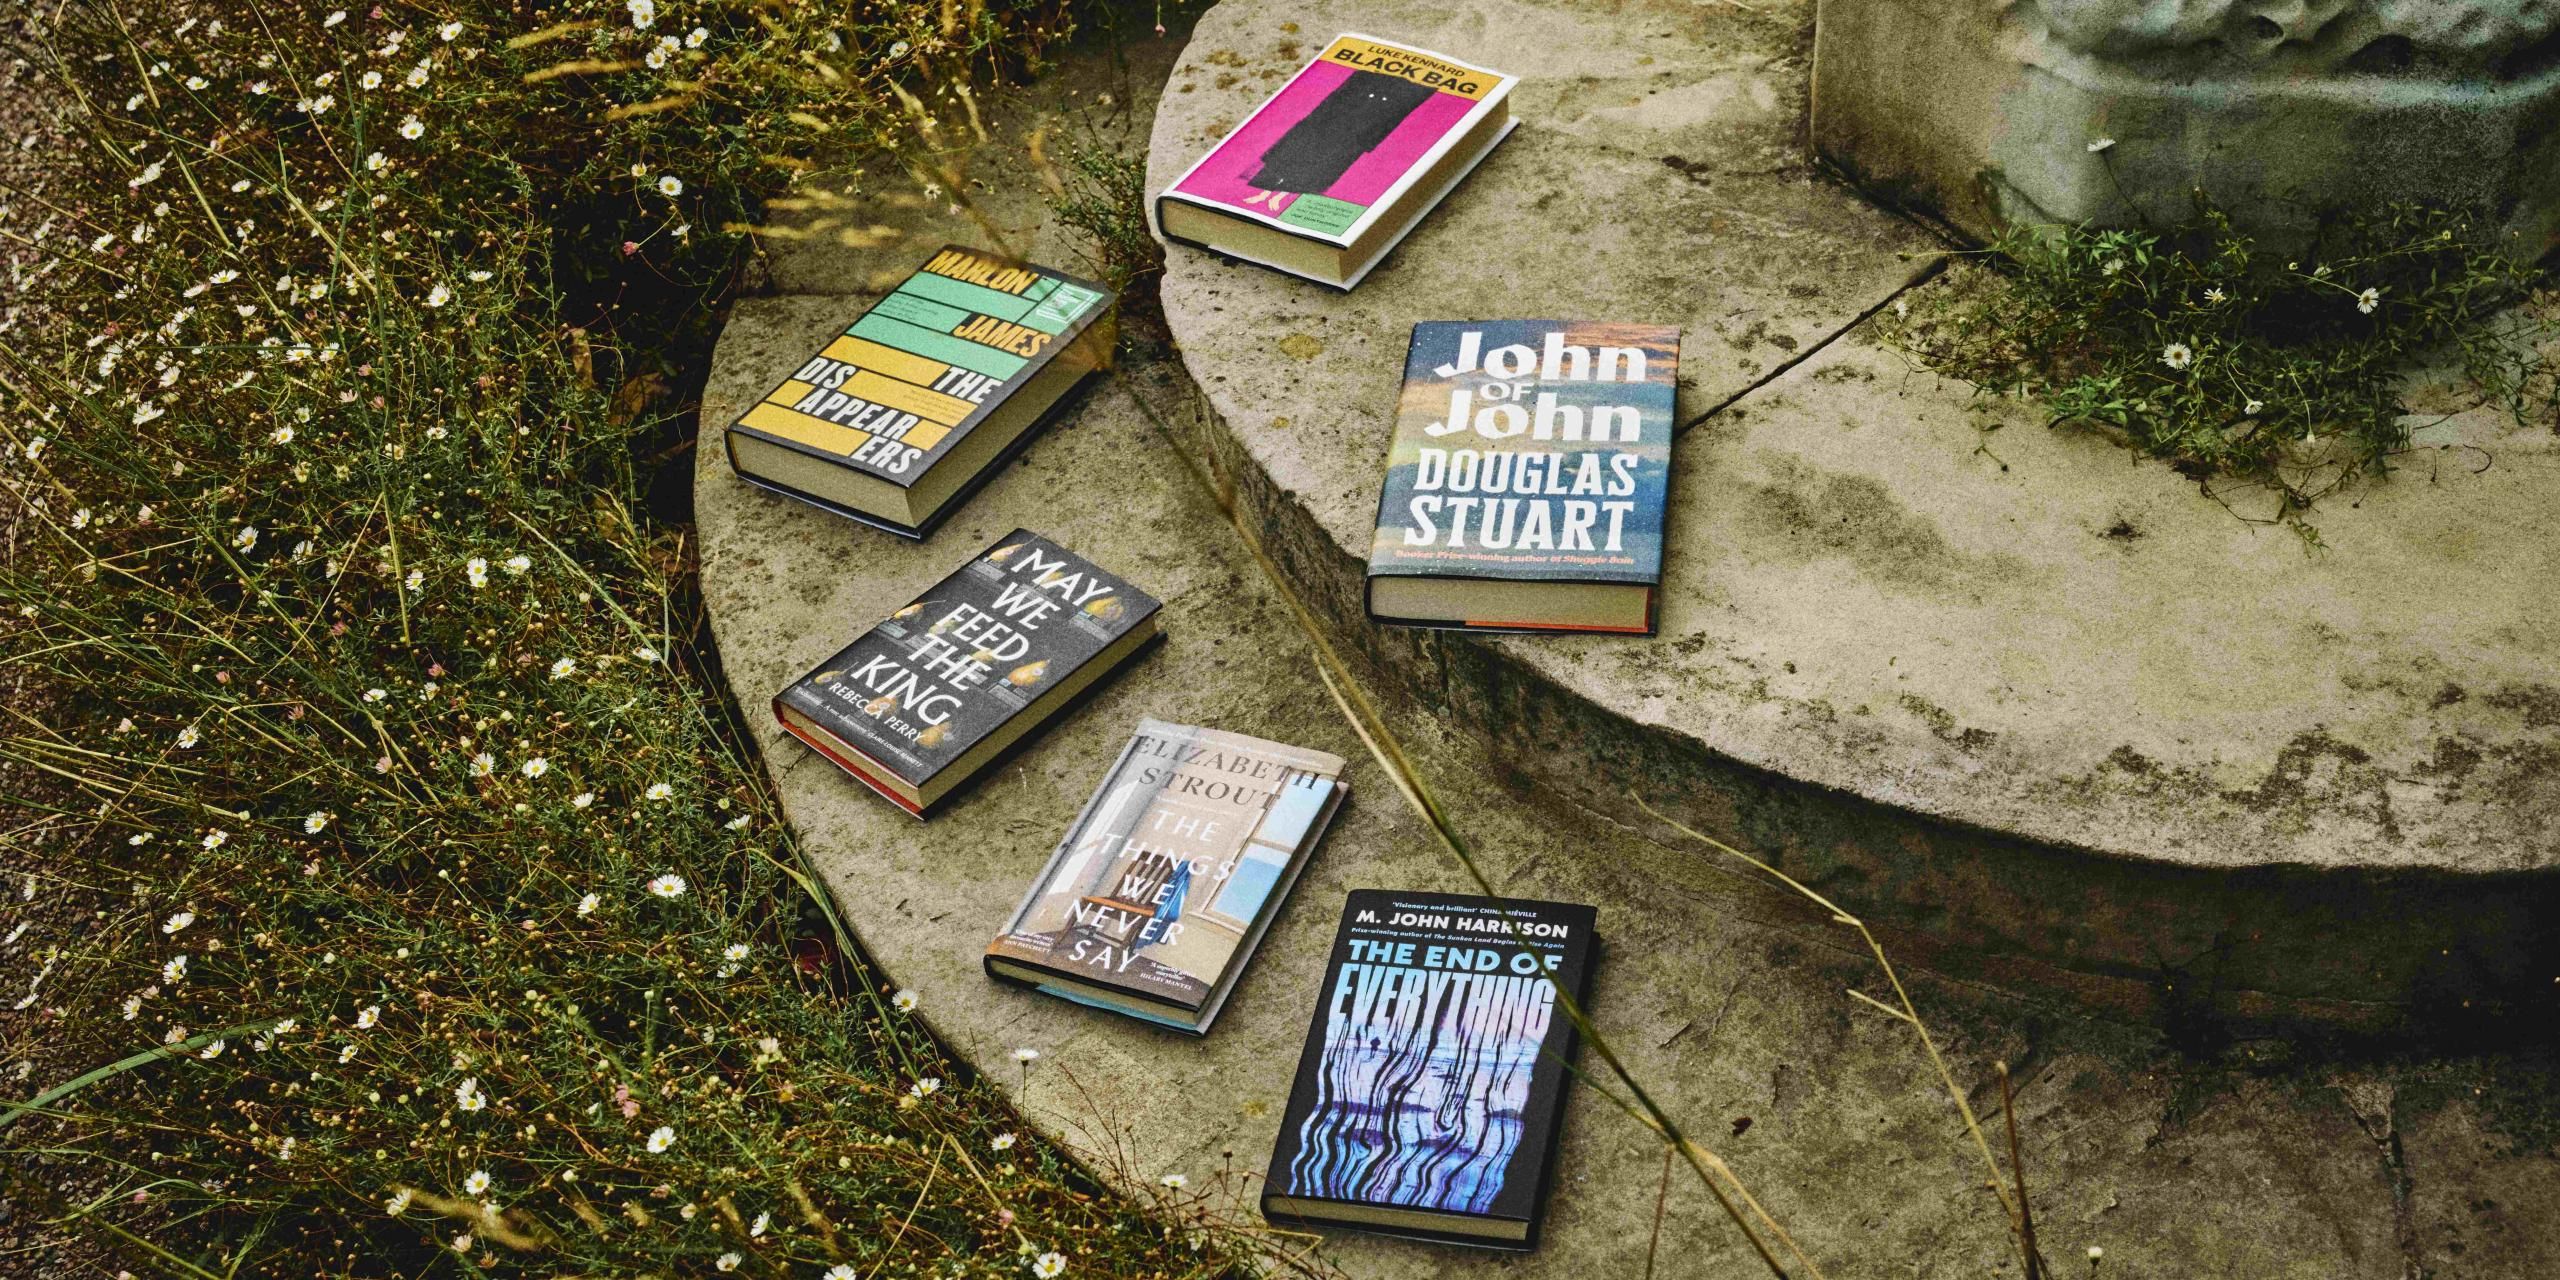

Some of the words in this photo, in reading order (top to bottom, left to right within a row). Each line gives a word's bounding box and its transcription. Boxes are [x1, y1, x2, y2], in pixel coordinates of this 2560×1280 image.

[1334, 48, 1422, 79] BLACK
[1422, 71, 1479, 95] BAG
[1367, 46, 1403, 59] LUKE
[1402, 53, 1465, 77] KENNARD
[923, 249, 1040, 295] MARLON
[952, 315, 1052, 358] JAMES
[1433, 331, 1648, 382] John
[793, 357, 857, 390] DIS
[933, 366, 1004, 404] THE
[1479, 382, 1535, 401] OF
[793, 387, 920, 439] APPEAR
[1423, 390, 1641, 442] John
[851, 435, 922, 475] ERS
[1412, 447, 1638, 497] DOUGLAS
[1403, 495, 1635, 551] STUART
[1011, 547, 1113, 607] MAY
[1510, 555, 1547, 563] author
[992, 582, 1061, 630] WE
[934, 602, 1030, 662] FEED
[907, 633, 991, 691] THE
[829, 682, 883, 719] REBECCA
[884, 716, 925, 742] PERRY
[851, 654, 962, 726] KING
[1138, 735, 1321, 790] ELIZABETH
[1138, 767, 1280, 810] STROUT
[1154, 809, 1221, 842] THE
[1102, 832, 1236, 882] THINGS
[1120, 875, 1175, 905] WE
[1063, 898, 1186, 946] NEVER
[1351, 927, 1398, 936] Prize-winning
[1355, 909, 1381, 924] M.
[1388, 912, 1450, 929] JOHN
[1068, 938, 1141, 974] SAY
[1349, 939, 1416, 966] THE
[1423, 946, 1501, 971] END
[1510, 952, 1563, 976] OF
[1328, 962, 1558, 1042] EVERYTHING
